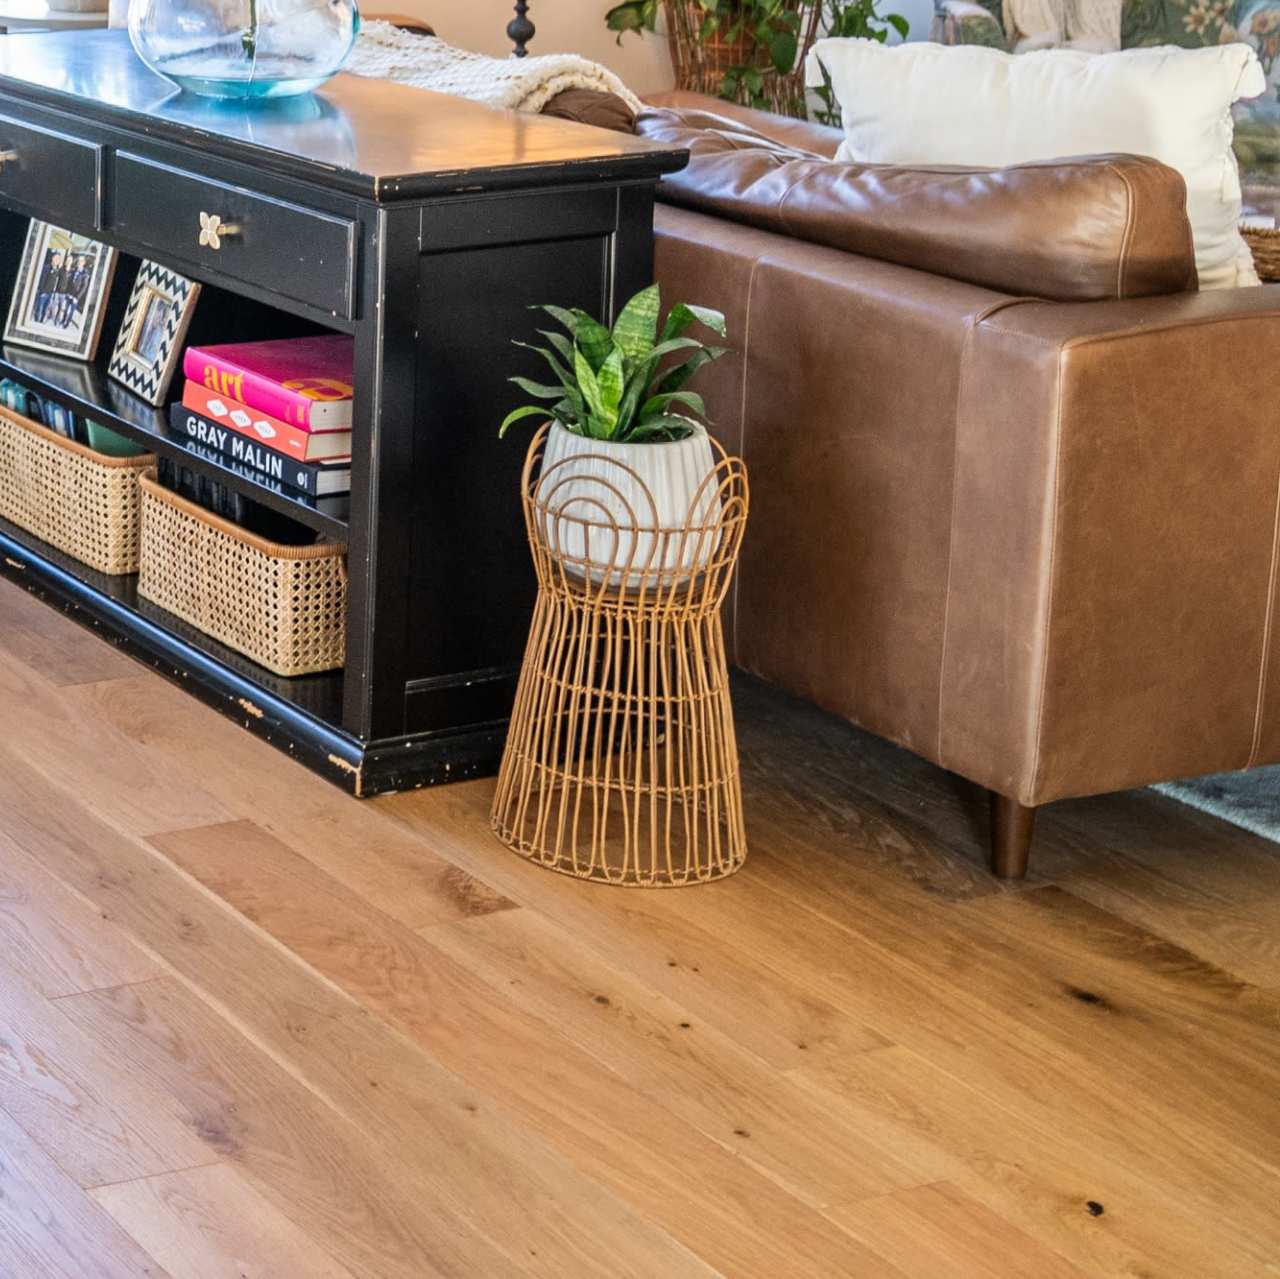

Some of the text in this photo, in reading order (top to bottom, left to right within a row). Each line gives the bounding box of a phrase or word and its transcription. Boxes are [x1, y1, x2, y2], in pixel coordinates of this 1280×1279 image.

[204, 365, 246, 404] art
[186, 416, 283, 478] GRAY MALIN
